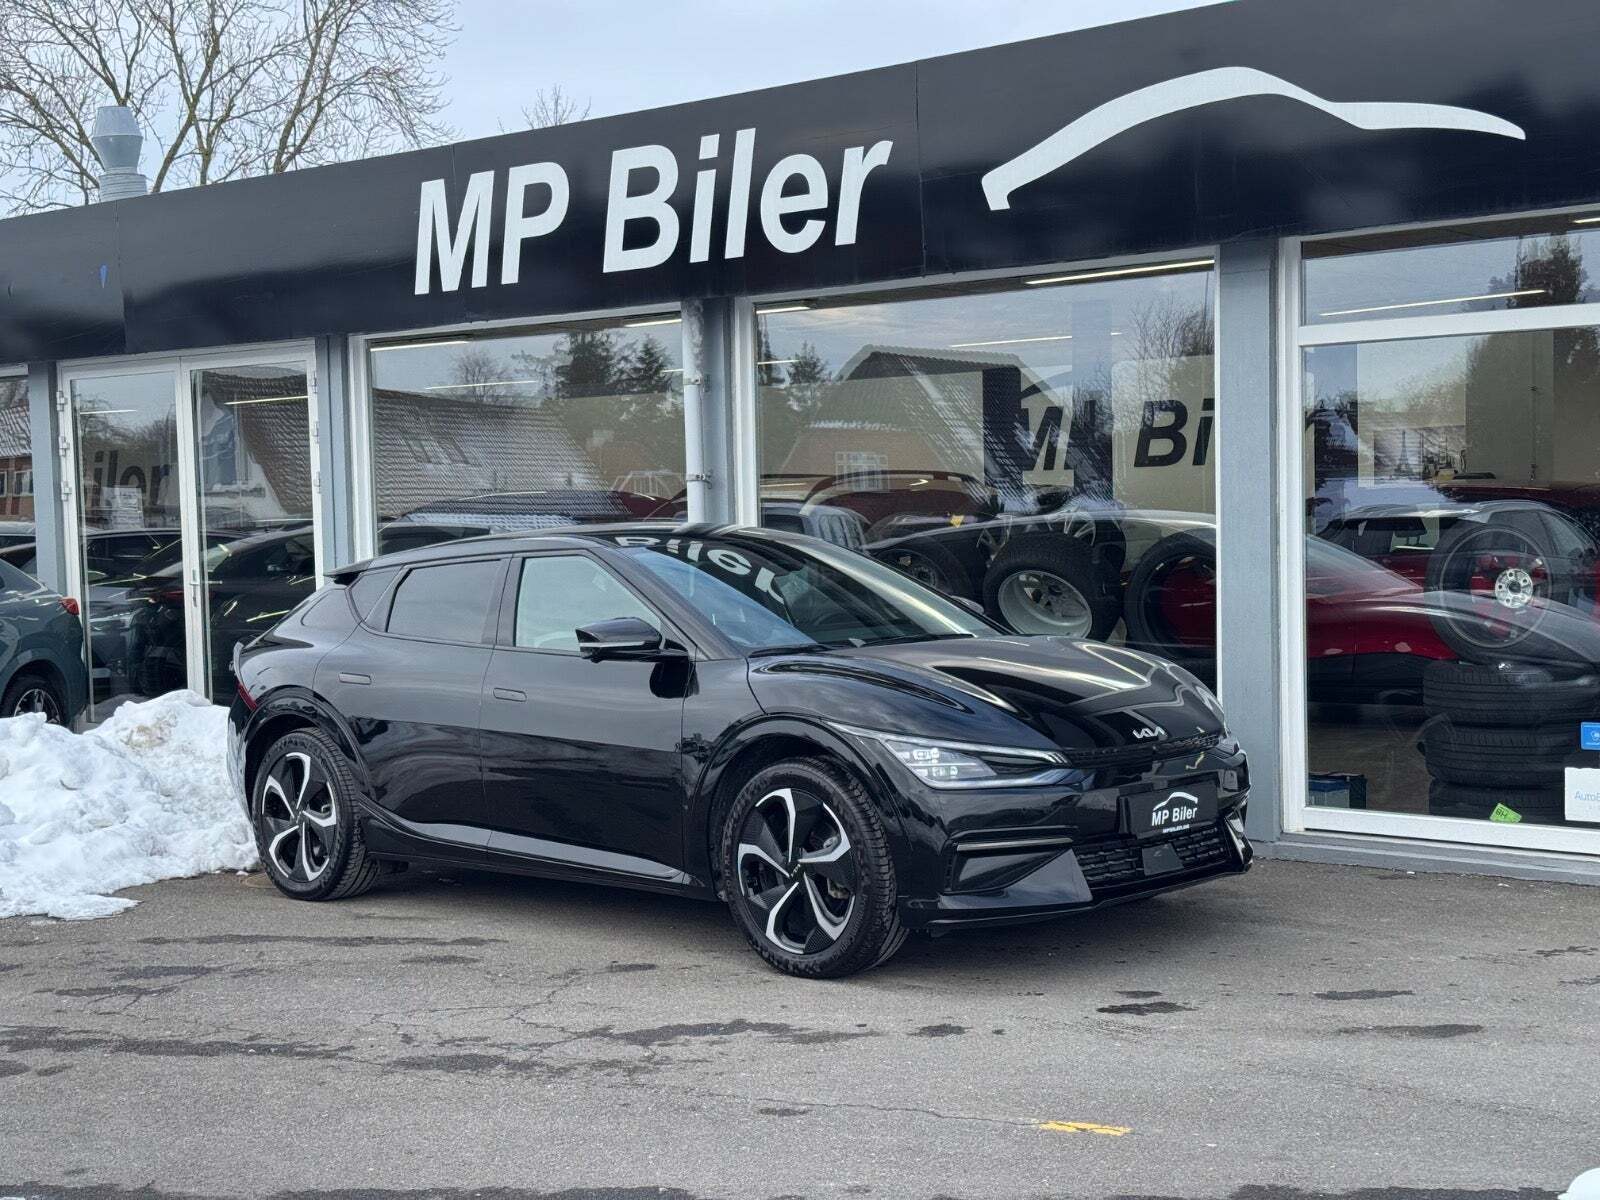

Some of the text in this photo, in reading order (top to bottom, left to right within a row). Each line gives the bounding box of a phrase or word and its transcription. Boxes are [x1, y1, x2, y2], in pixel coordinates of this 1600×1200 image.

[414, 127, 893, 296] MP Biler
[1151, 805, 1198, 827] MP Biler
